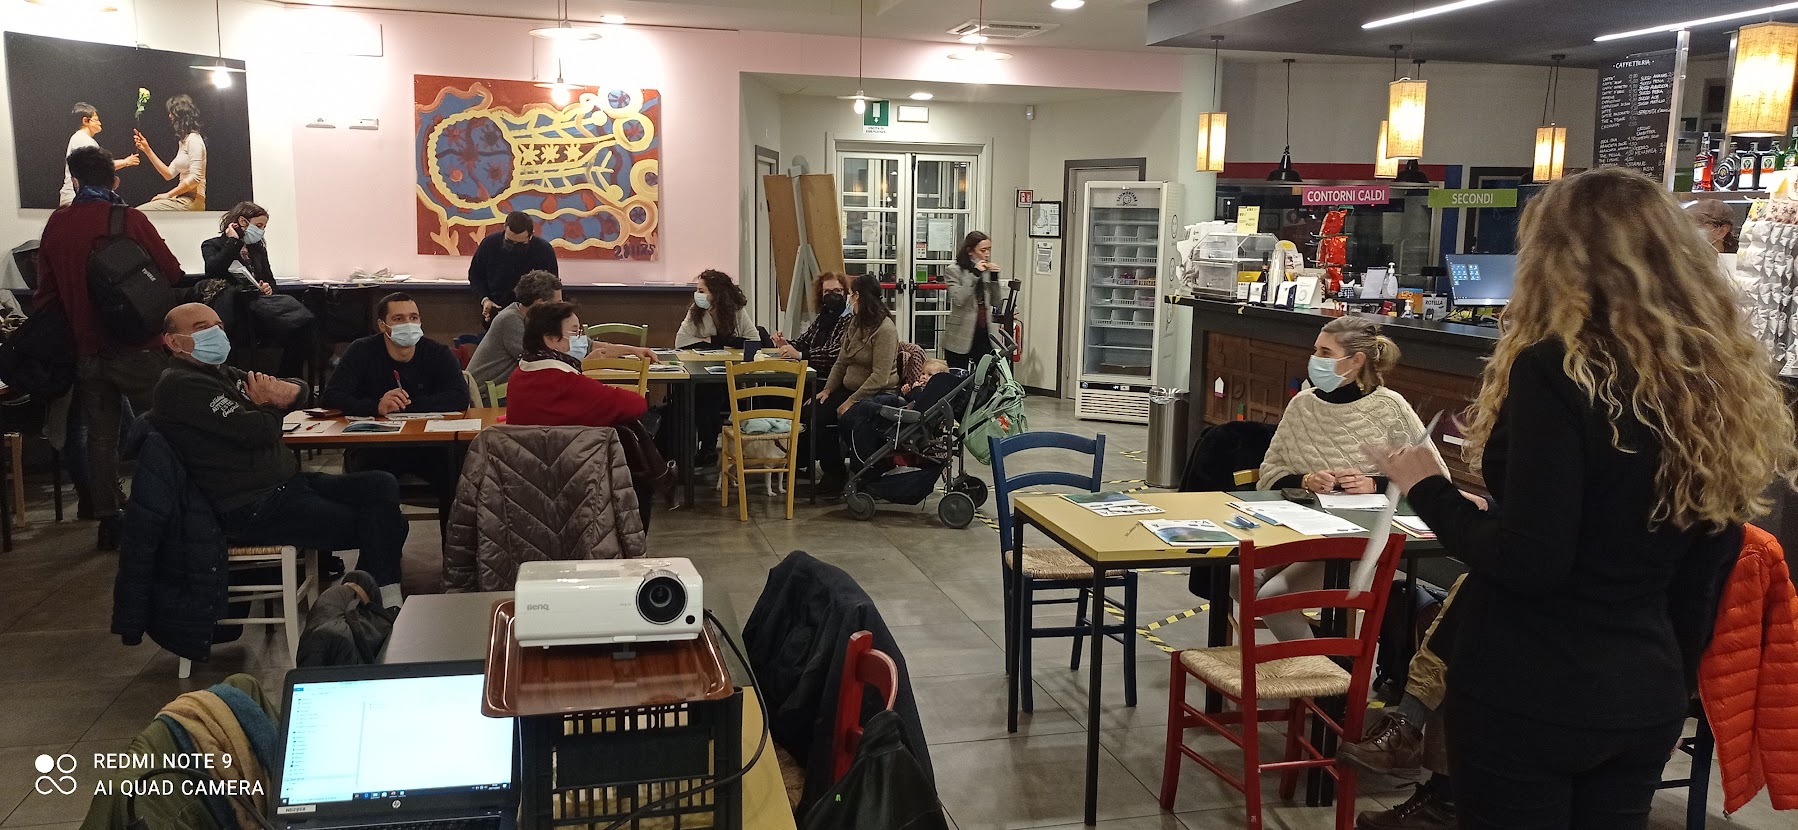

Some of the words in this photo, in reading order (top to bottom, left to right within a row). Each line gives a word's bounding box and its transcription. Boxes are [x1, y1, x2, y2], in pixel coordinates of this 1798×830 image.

[1307, 189, 1356, 203] CONTORNI
[1358, 189, 1385, 201] CALDI
[1451, 193, 1494, 205] SECONDI
